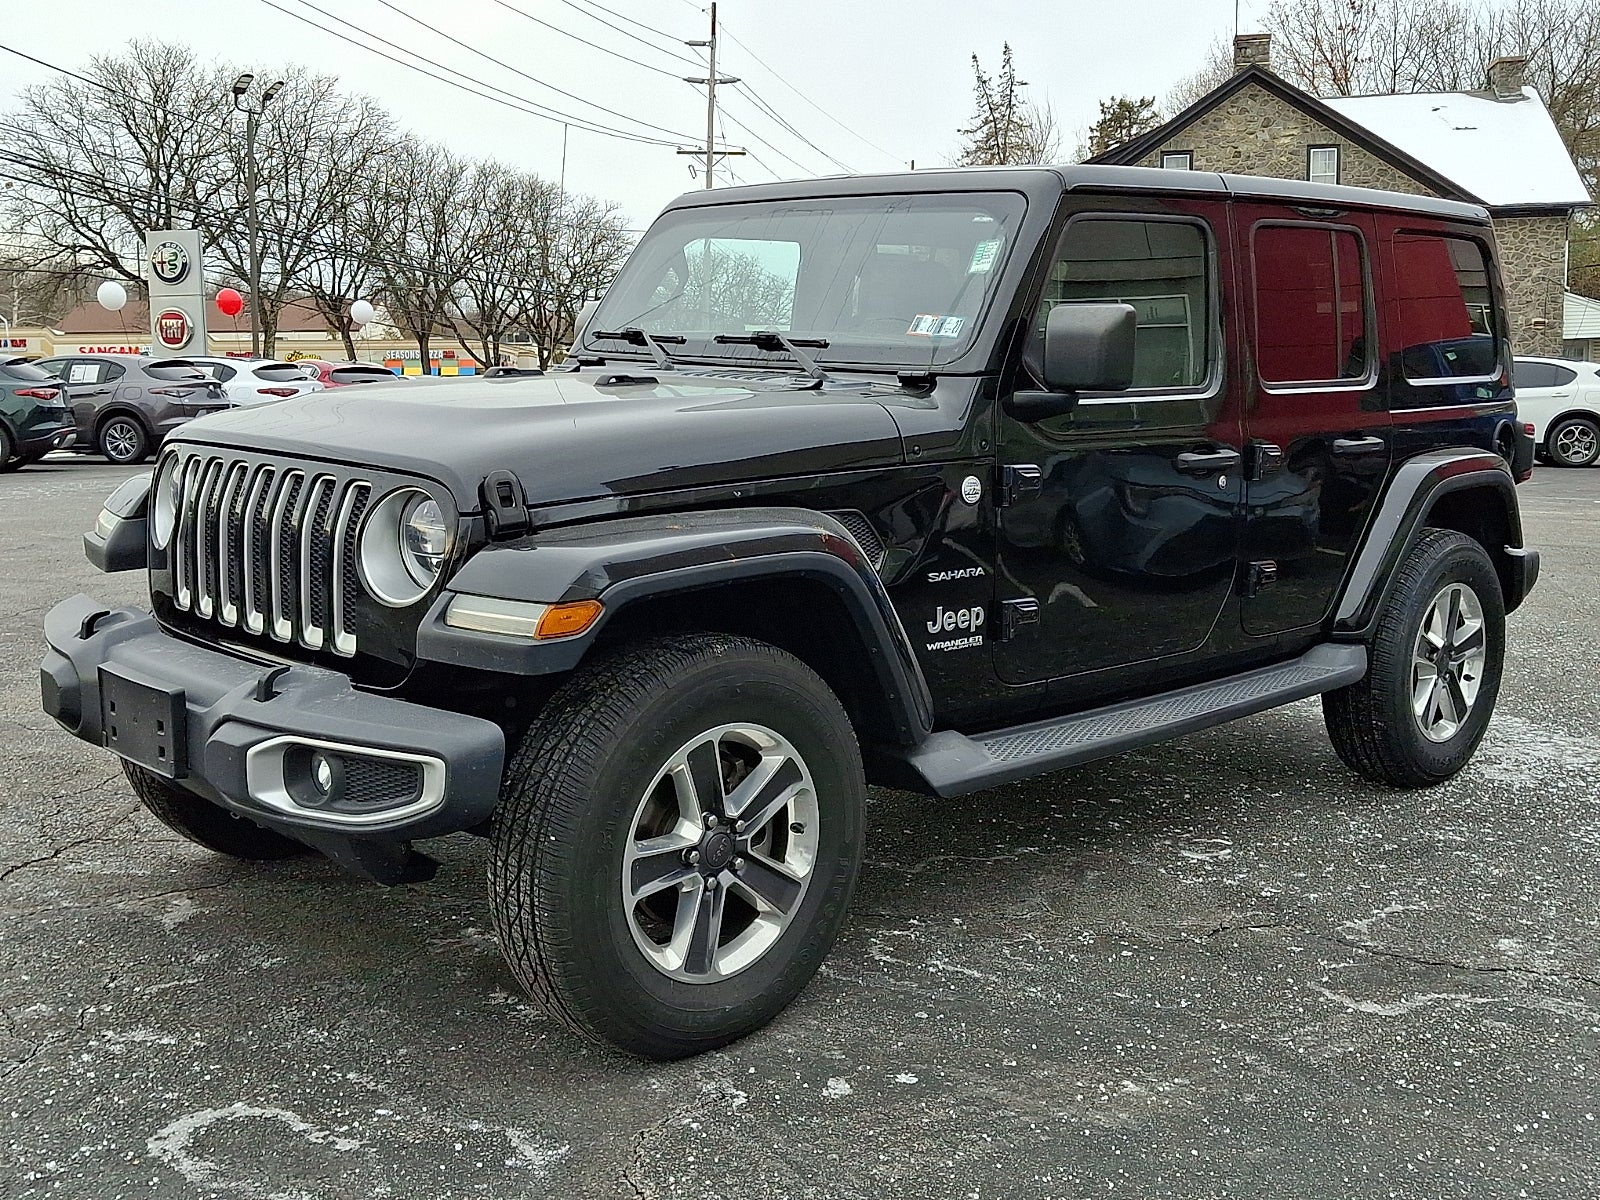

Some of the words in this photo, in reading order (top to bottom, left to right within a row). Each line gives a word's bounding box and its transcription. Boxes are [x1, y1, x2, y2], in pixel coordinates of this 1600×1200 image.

[79, 346, 140, 354] SANGAM
[386, 350, 420, 359] SEASONS
[927, 567, 985, 583] SAHARA
[926, 606, 985, 633] Jeep
[926, 635, 983, 651] WRANGLER
